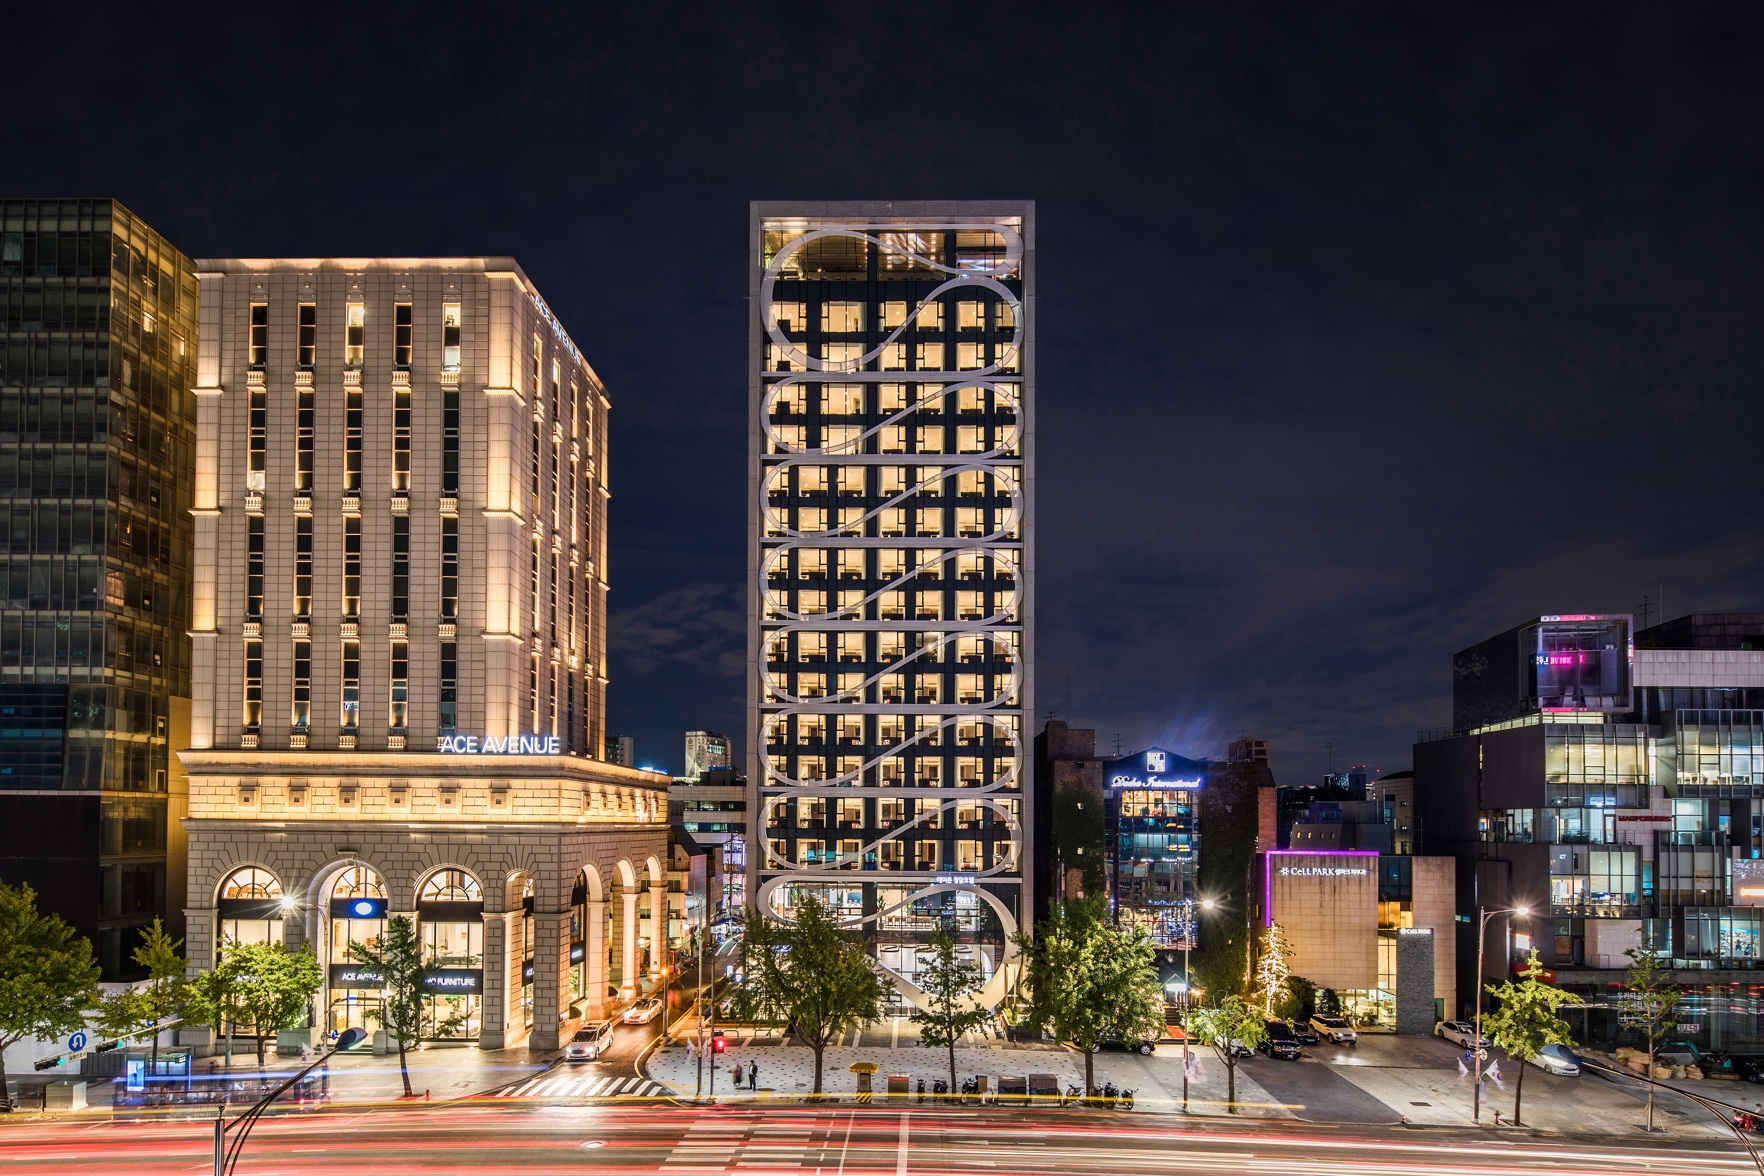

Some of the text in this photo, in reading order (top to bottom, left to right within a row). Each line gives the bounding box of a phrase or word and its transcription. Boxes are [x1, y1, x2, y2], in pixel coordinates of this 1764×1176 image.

[534, 295, 551, 321] ACE
[441, 736, 560, 753] ACE AVENUE
[1312, 867, 1335, 876] PARK
[341, 972, 356, 981] ACE
[437, 977, 475, 986] FURNITURE
